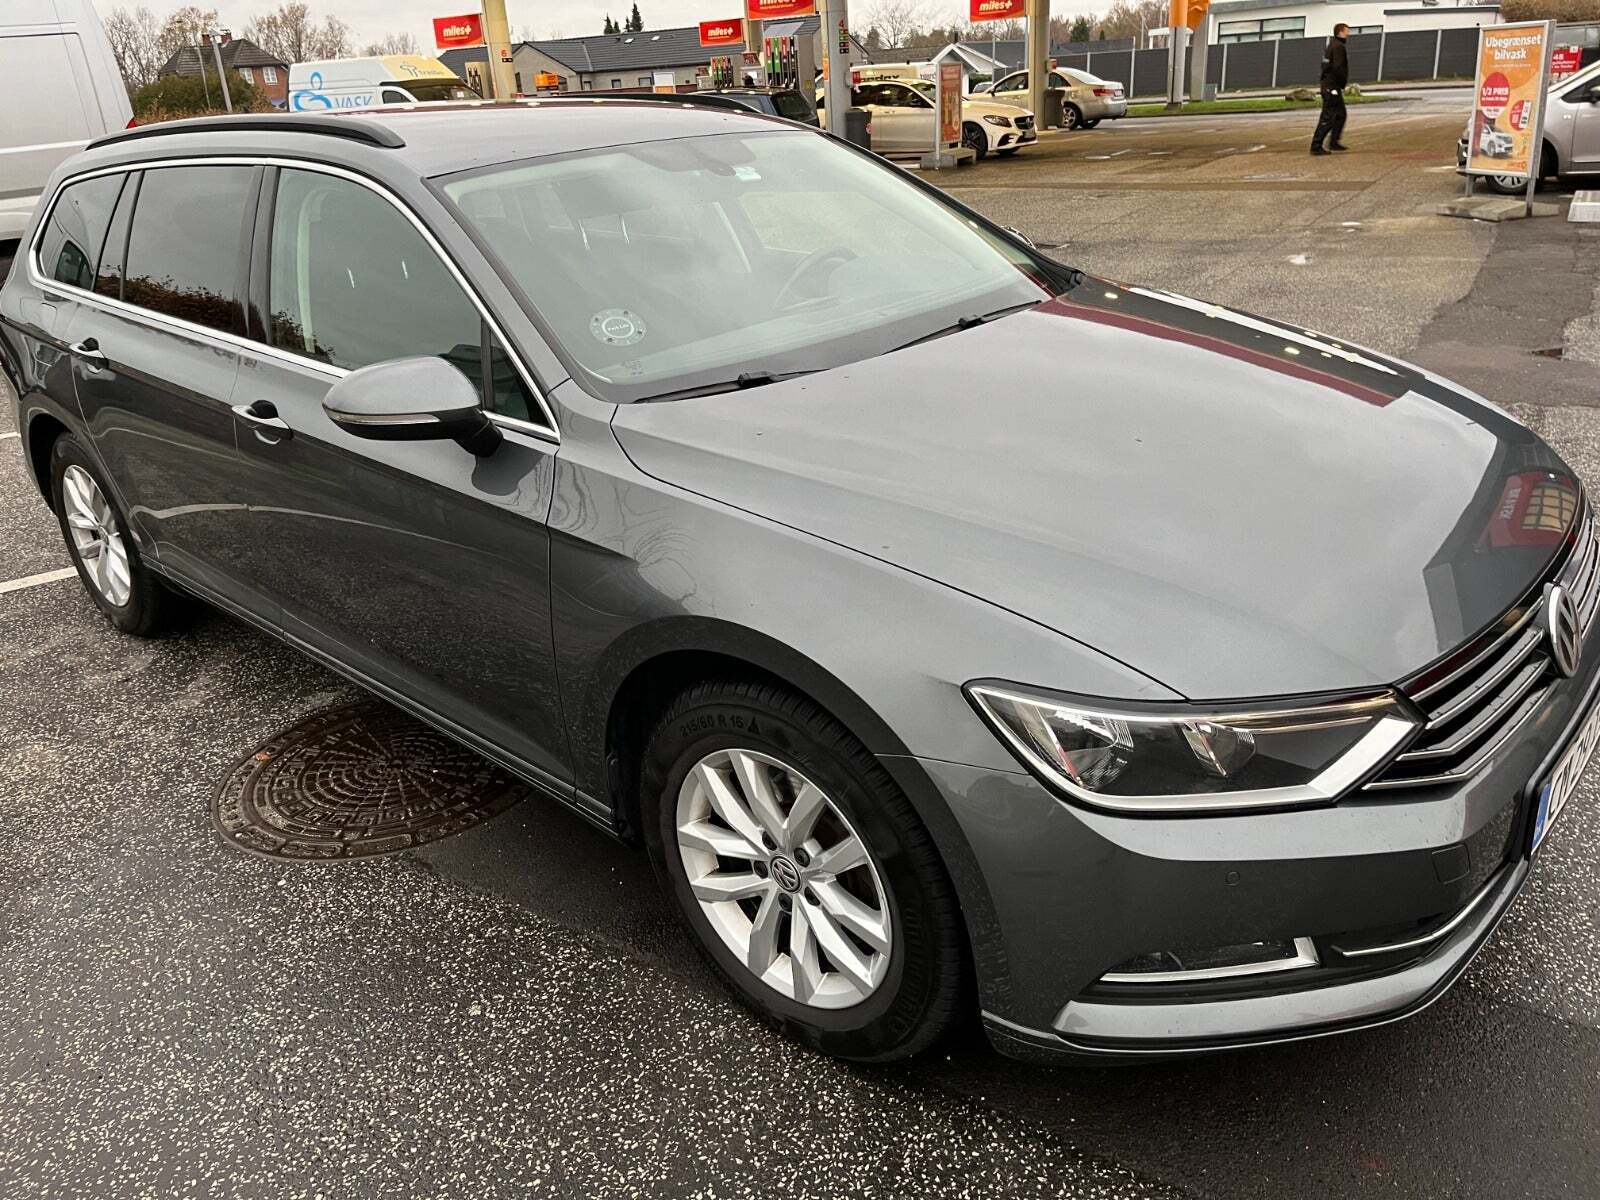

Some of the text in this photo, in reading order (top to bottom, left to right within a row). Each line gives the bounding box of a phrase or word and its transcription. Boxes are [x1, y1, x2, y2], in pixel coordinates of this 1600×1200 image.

[1485, 34, 1541, 48] Ubegrænset
[1494, 48, 1527, 60] bilvask
[680, 714, 744, 737] 215/60 R 16
